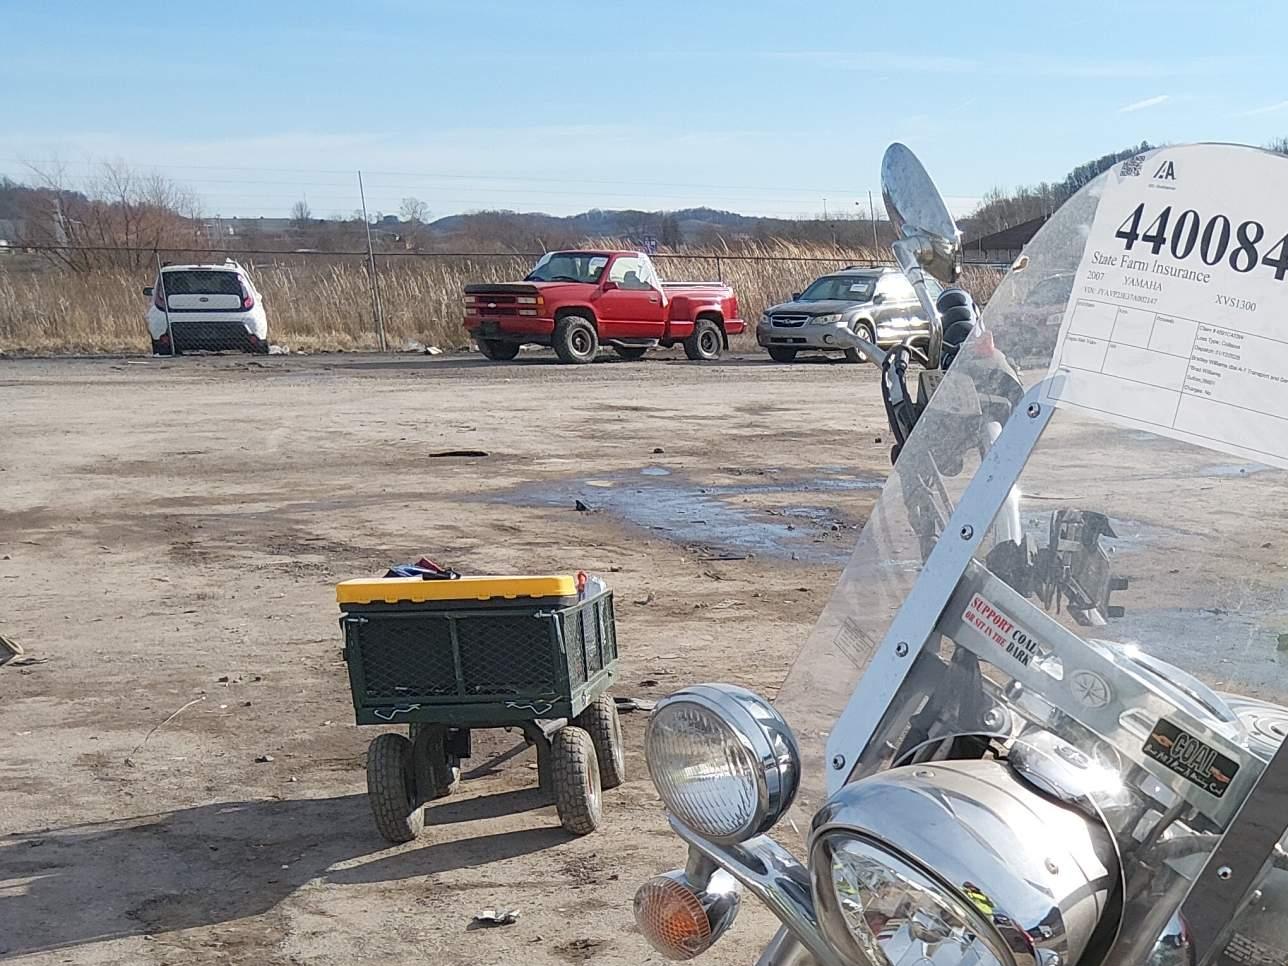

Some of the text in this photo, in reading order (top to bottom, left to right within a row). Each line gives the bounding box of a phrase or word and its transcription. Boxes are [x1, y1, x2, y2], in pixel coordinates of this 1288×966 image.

[1091, 251, 1211, 283] State Farm Insurance
[1087, 270, 1257, 312] 2007 YAMAHA XVS1300
[965, 610, 1031, 666] OR SIT IN THE DARK
[971, 597, 1037, 654] SUPPORT COAL
[1170, 732, 1218, 778] COAL
